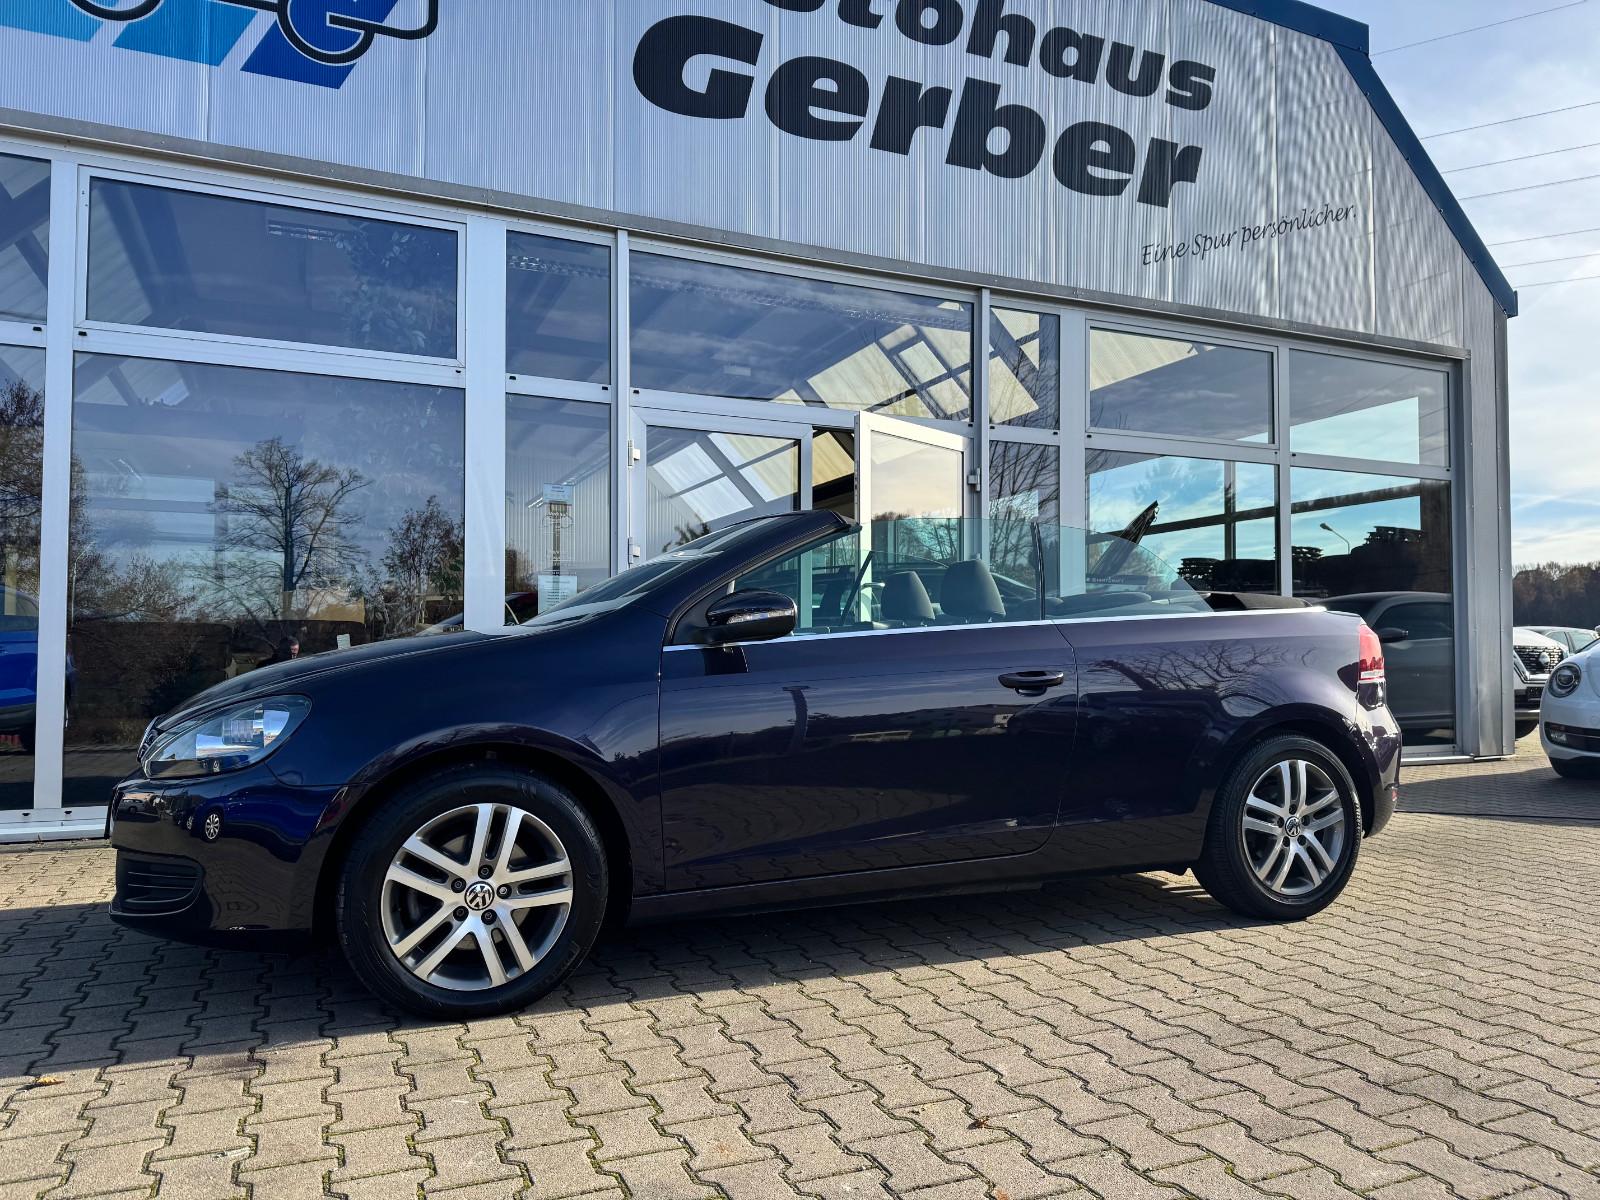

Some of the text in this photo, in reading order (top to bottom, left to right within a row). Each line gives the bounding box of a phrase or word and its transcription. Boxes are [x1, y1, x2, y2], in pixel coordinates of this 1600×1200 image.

[763, 0, 1216, 111] ohaus
[632, 15, 1203, 208] Gerber
[1141, 203, 1358, 265] Eine Spur persönlicher.
